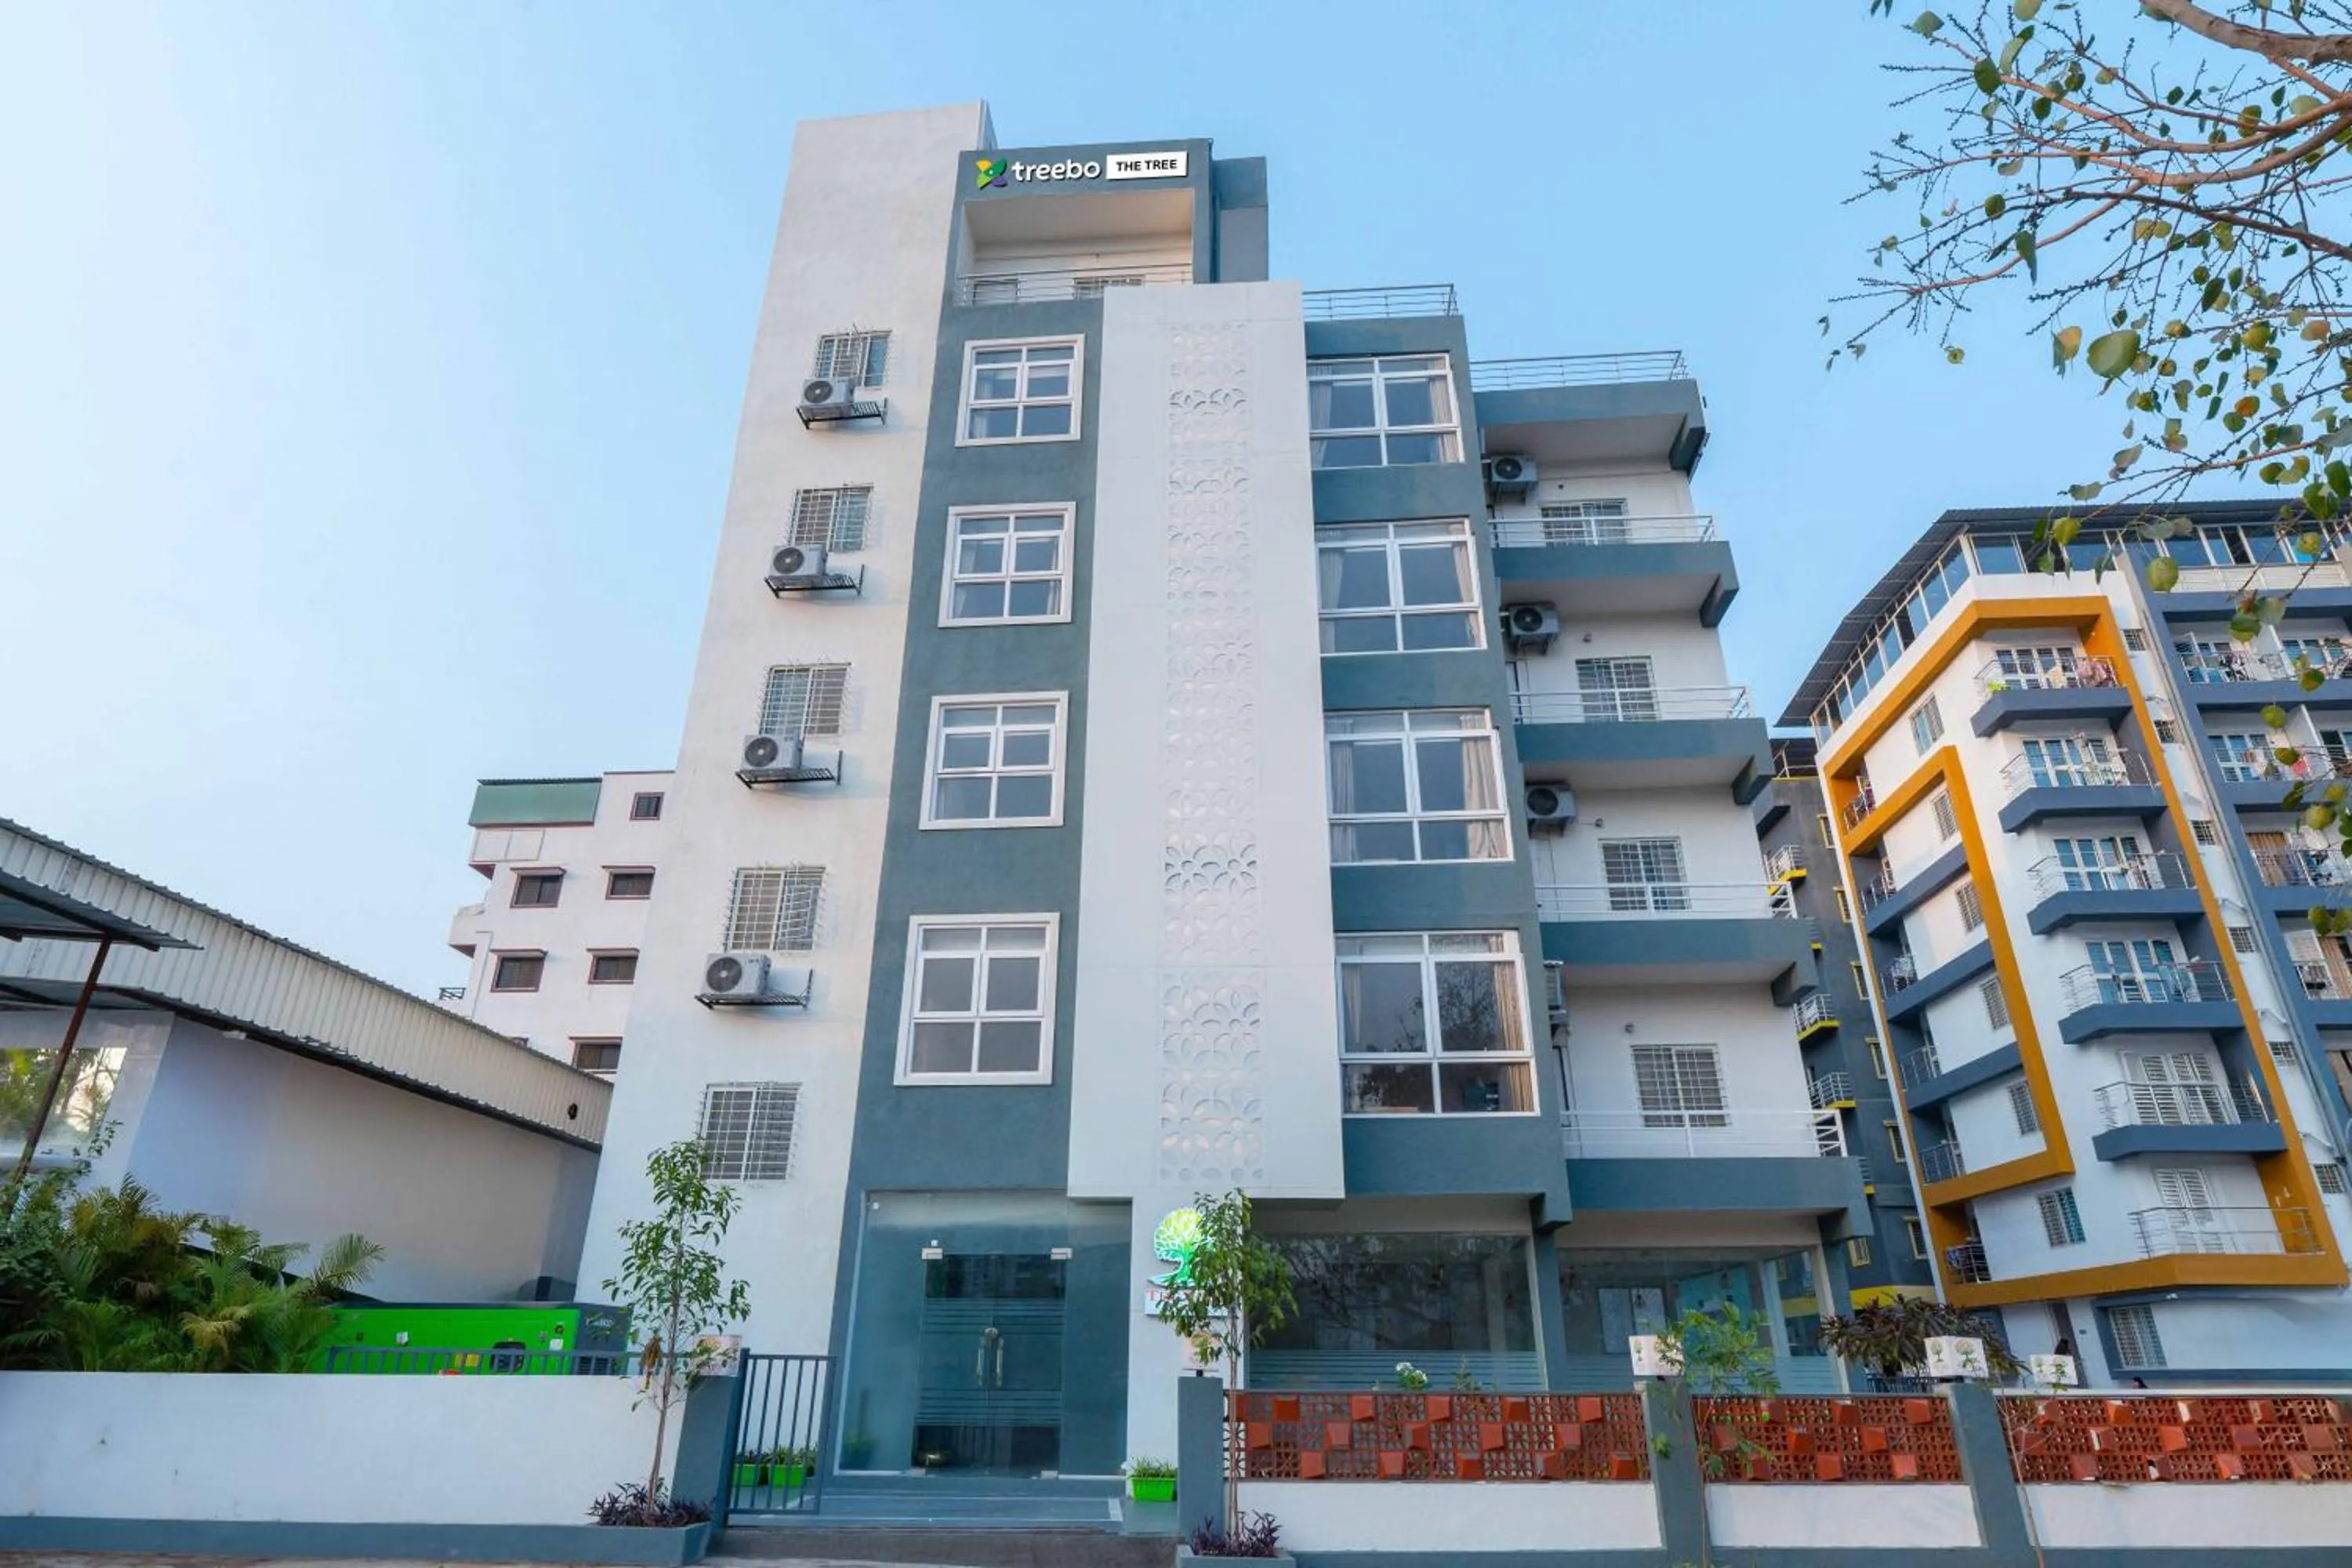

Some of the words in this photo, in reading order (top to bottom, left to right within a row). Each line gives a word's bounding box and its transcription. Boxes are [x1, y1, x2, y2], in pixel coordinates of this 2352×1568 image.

[1011, 159, 1101, 182] treebo
[1116, 161, 1142, 172] THE
[1145, 159, 1178, 170] TREE
